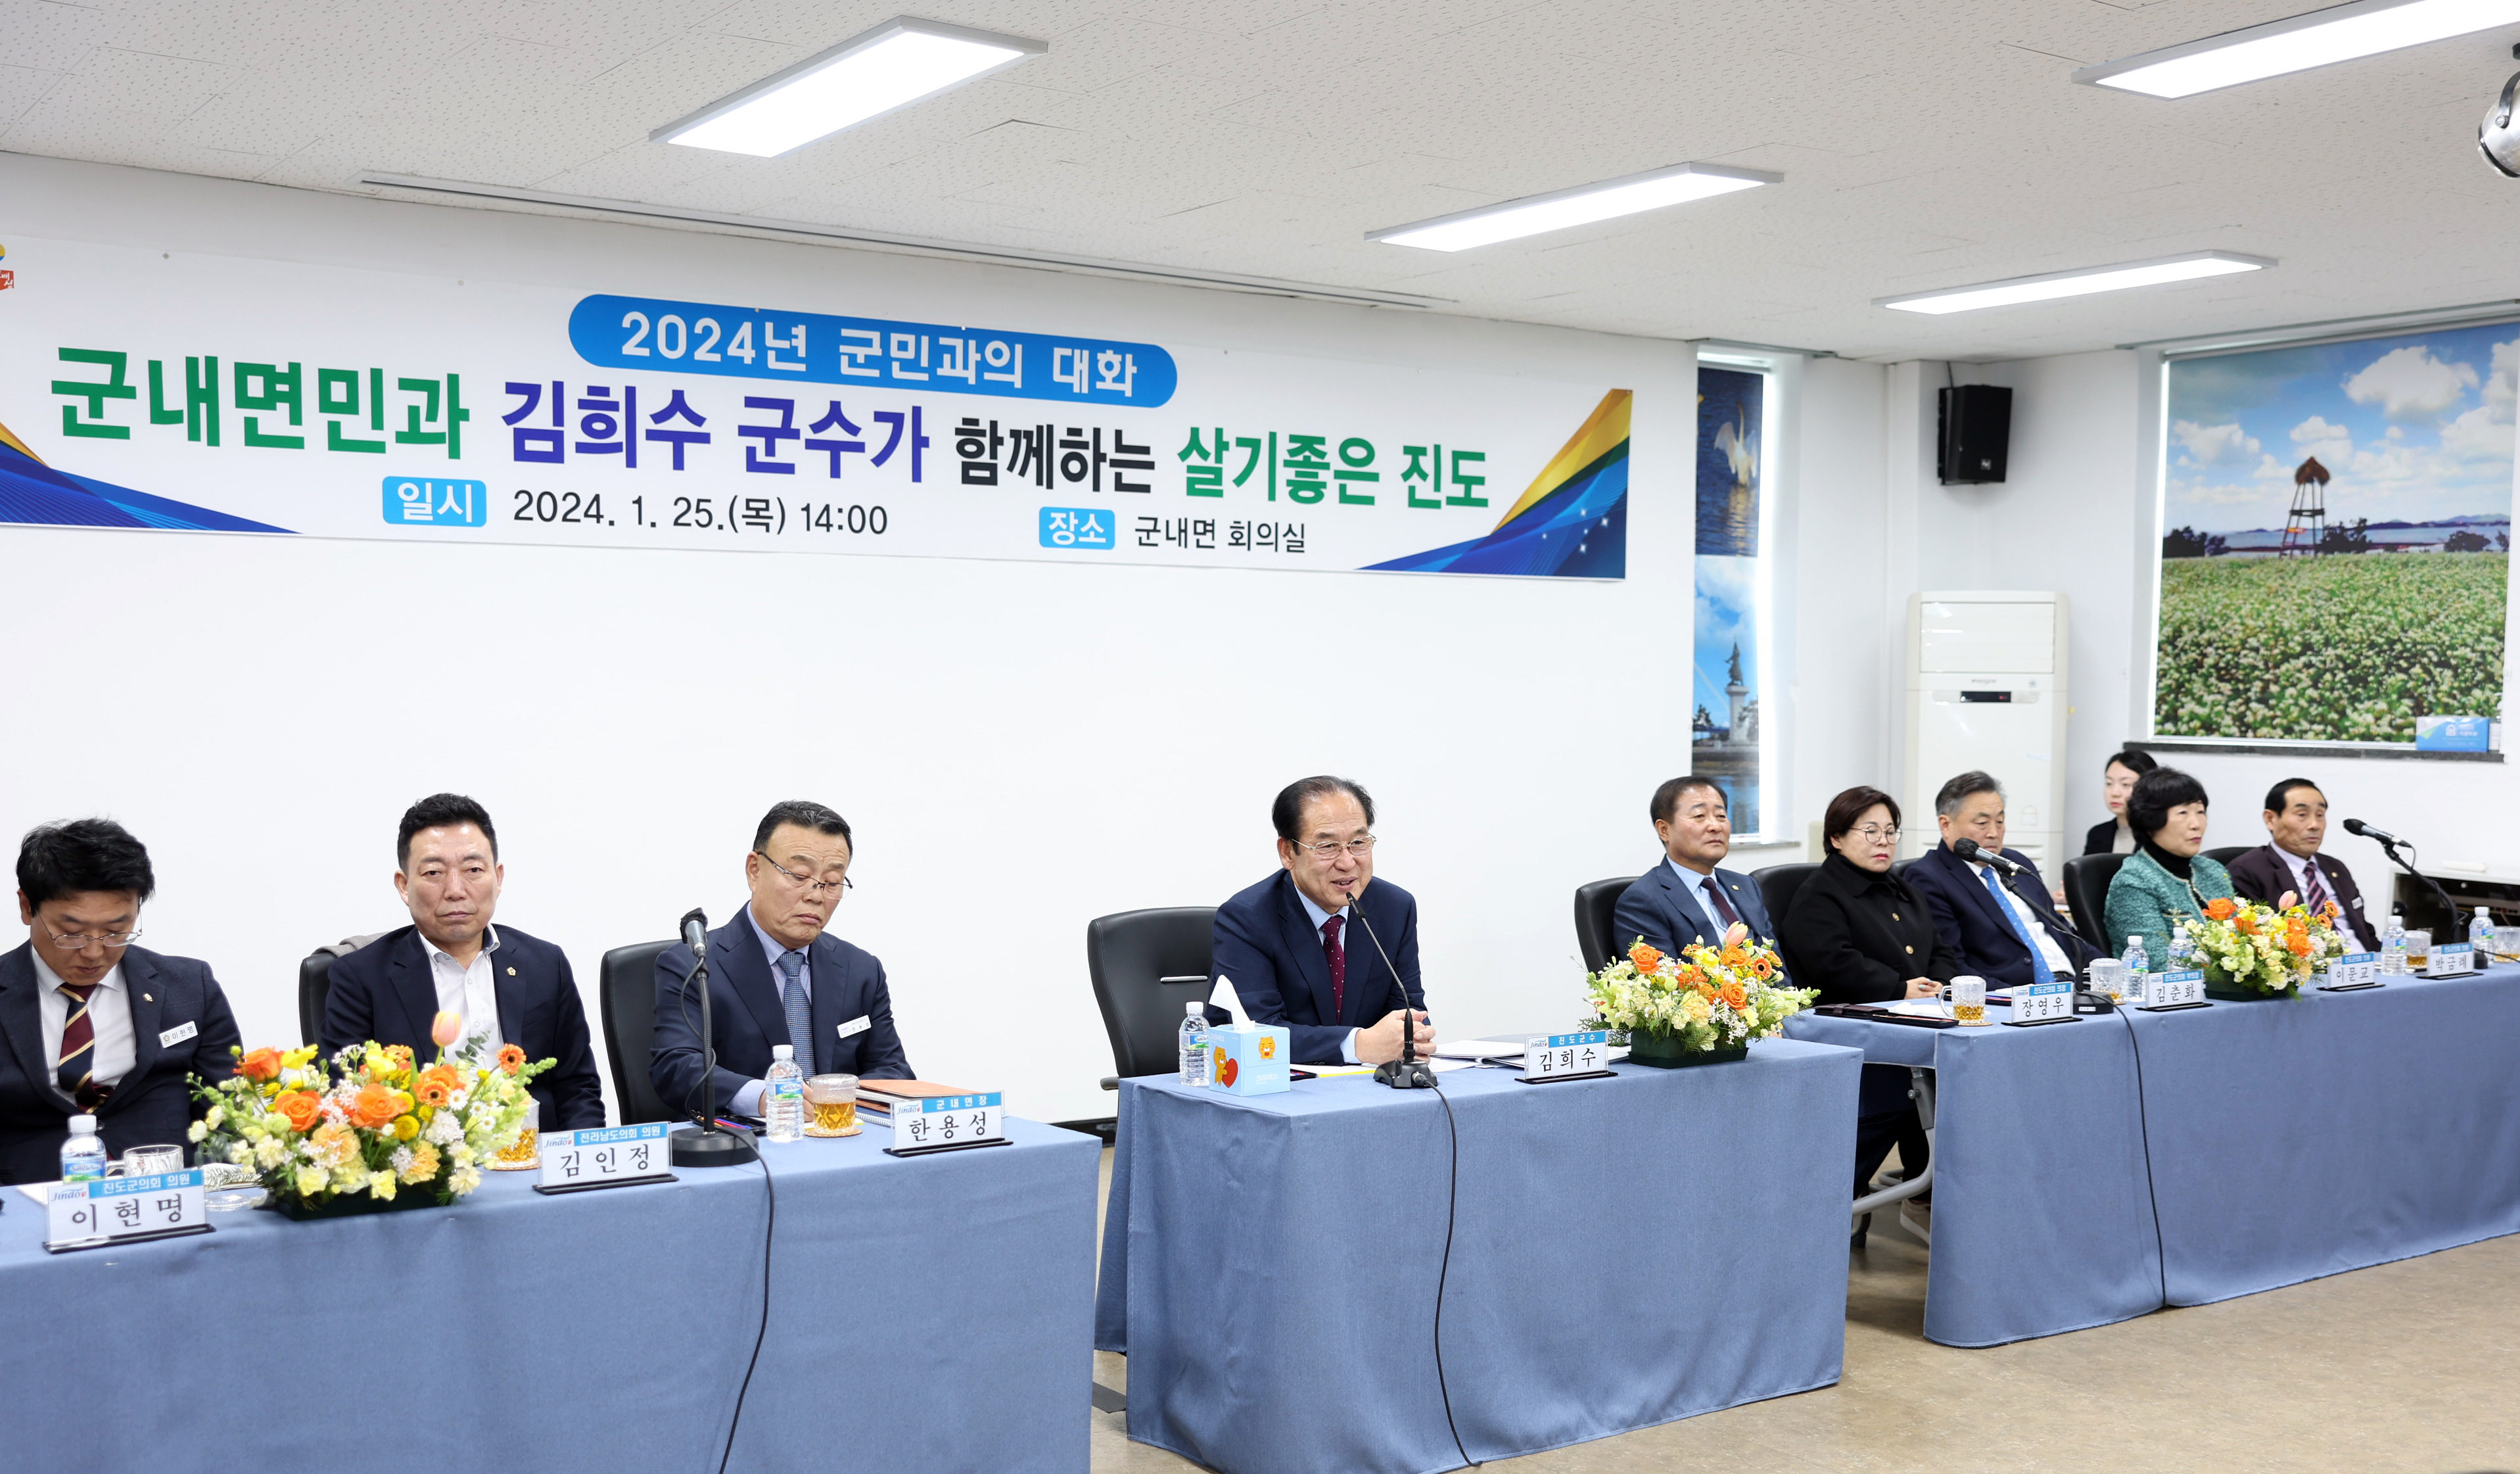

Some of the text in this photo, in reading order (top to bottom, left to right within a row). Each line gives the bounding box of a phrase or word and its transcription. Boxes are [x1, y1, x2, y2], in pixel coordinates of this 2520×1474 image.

[620, 310, 1138, 398] 2024년 군민과의 대화
[51, 347, 1489, 510] 군내면민과 김희수 군수가 함께하는 살기좋은 진도
[397, 481, 888, 535] 일시 2024. 1. 25.(목) 14:00
[1048, 511, 1306, 554] 장소 군내면 회의실
[2435, 954, 2467, 972] 박금례
[2337, 966, 2369, 983] 이문교
[2034, 986, 2056, 995] 진도군의회
[2157, 983, 2195, 1003] 김춘화
[2022, 996, 2064, 1017] 장영우
[172, 1026, 194, 1039] 이현명
[1558, 1034, 1596, 1045] 진도군수
[1539, 1048, 1597, 1072] 김희수
[897, 1106, 917, 1115] Jindo
[936, 1095, 988, 1110] 군내면장
[580, 1126, 661, 1144] 전라남도의회 의원
[908, 1111, 987, 1142] 한용성
[544, 1138, 568, 1149] Jindo
[560, 1143, 649, 1178] 김인정
[103, 1174, 191, 1195] 진도군의회 의원
[51, 1191, 81, 1202] Jindo
[72, 1193, 182, 1233] 이현명
